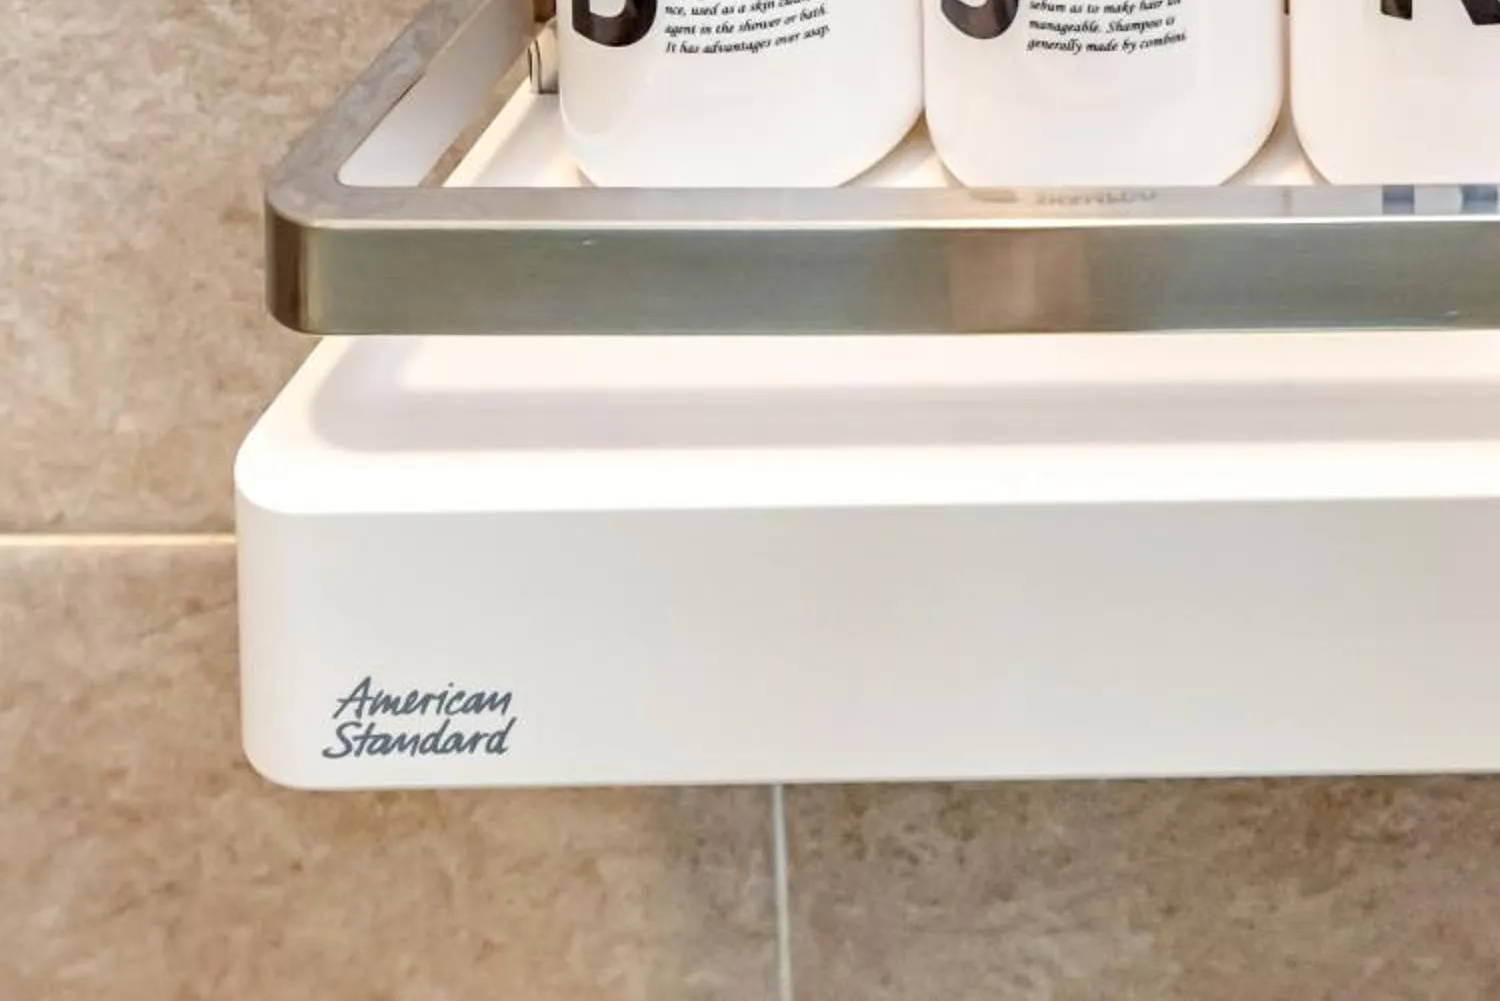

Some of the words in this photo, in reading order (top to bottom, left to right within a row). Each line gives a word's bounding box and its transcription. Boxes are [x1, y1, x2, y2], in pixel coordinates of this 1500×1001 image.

[691, 2, 719, 16] used
[1029, 0, 1066, 13] sebum
[664, 24, 696, 37] agent
[715, 21, 735, 34] the
[680, 39, 699, 54] has
[1027, 38, 1083, 55] generally
[1086, 39, 1118, 52] made
[1122, 38, 1136, 54] by
[332, 675, 513, 719] American
[321, 716, 518, 759] Standard
